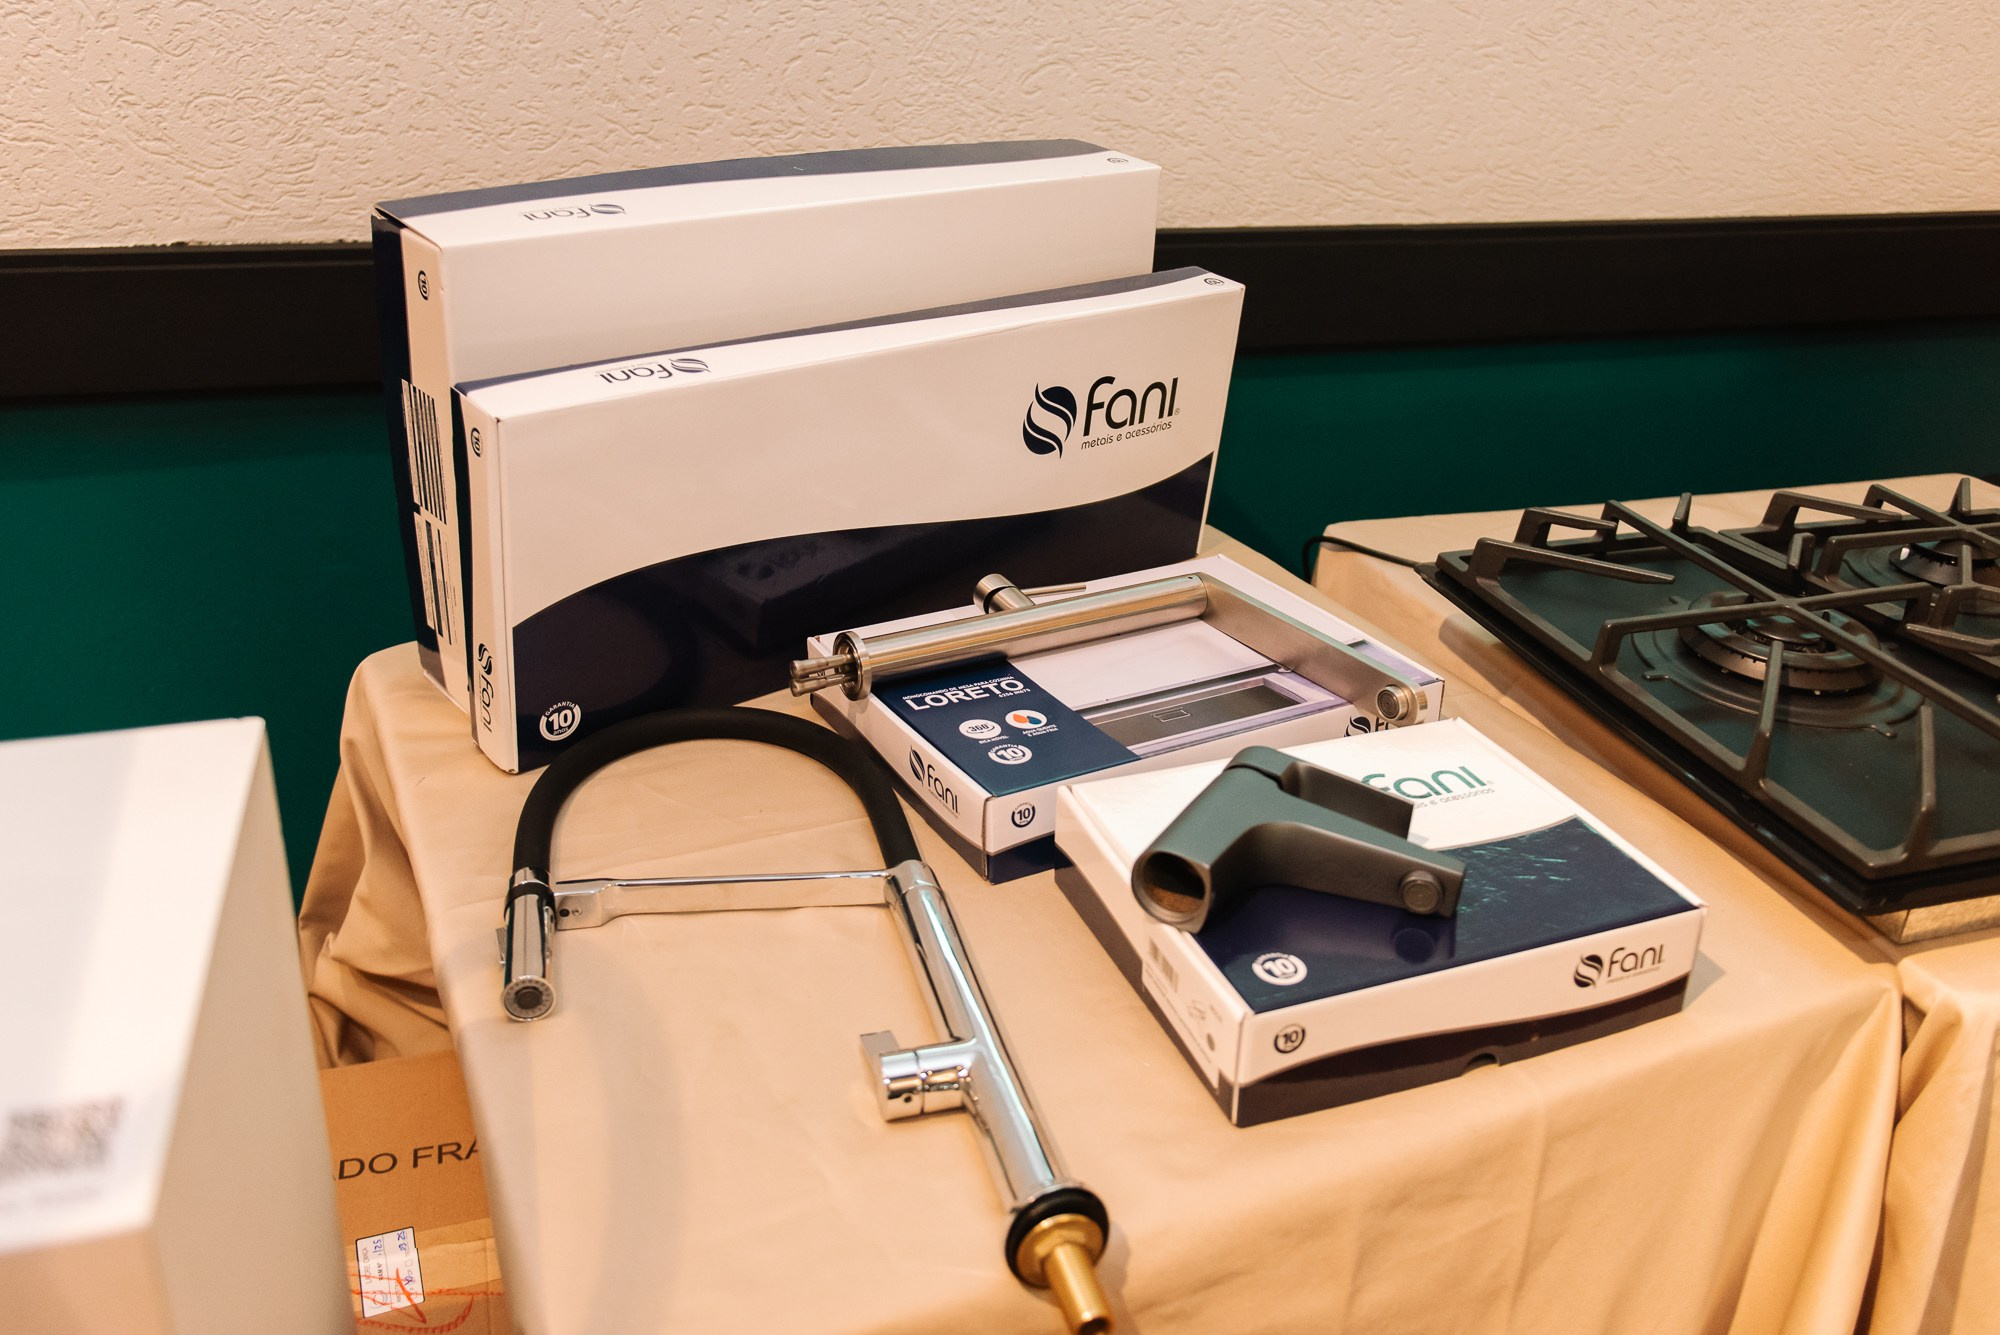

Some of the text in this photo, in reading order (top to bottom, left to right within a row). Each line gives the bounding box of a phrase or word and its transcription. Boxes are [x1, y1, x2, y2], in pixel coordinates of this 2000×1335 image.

[1080, 421, 1172, 450] metais e acessórios
[905, 679, 1025, 711] LORETO
[545, 700, 575, 717] GARANTIA
[548, 709, 573, 731] 10
[997, 749, 1023, 761] 10
[1017, 807, 1031, 821] 10
[1262, 957, 1297, 979] 10
[1283, 1030, 1300, 1046] 10
